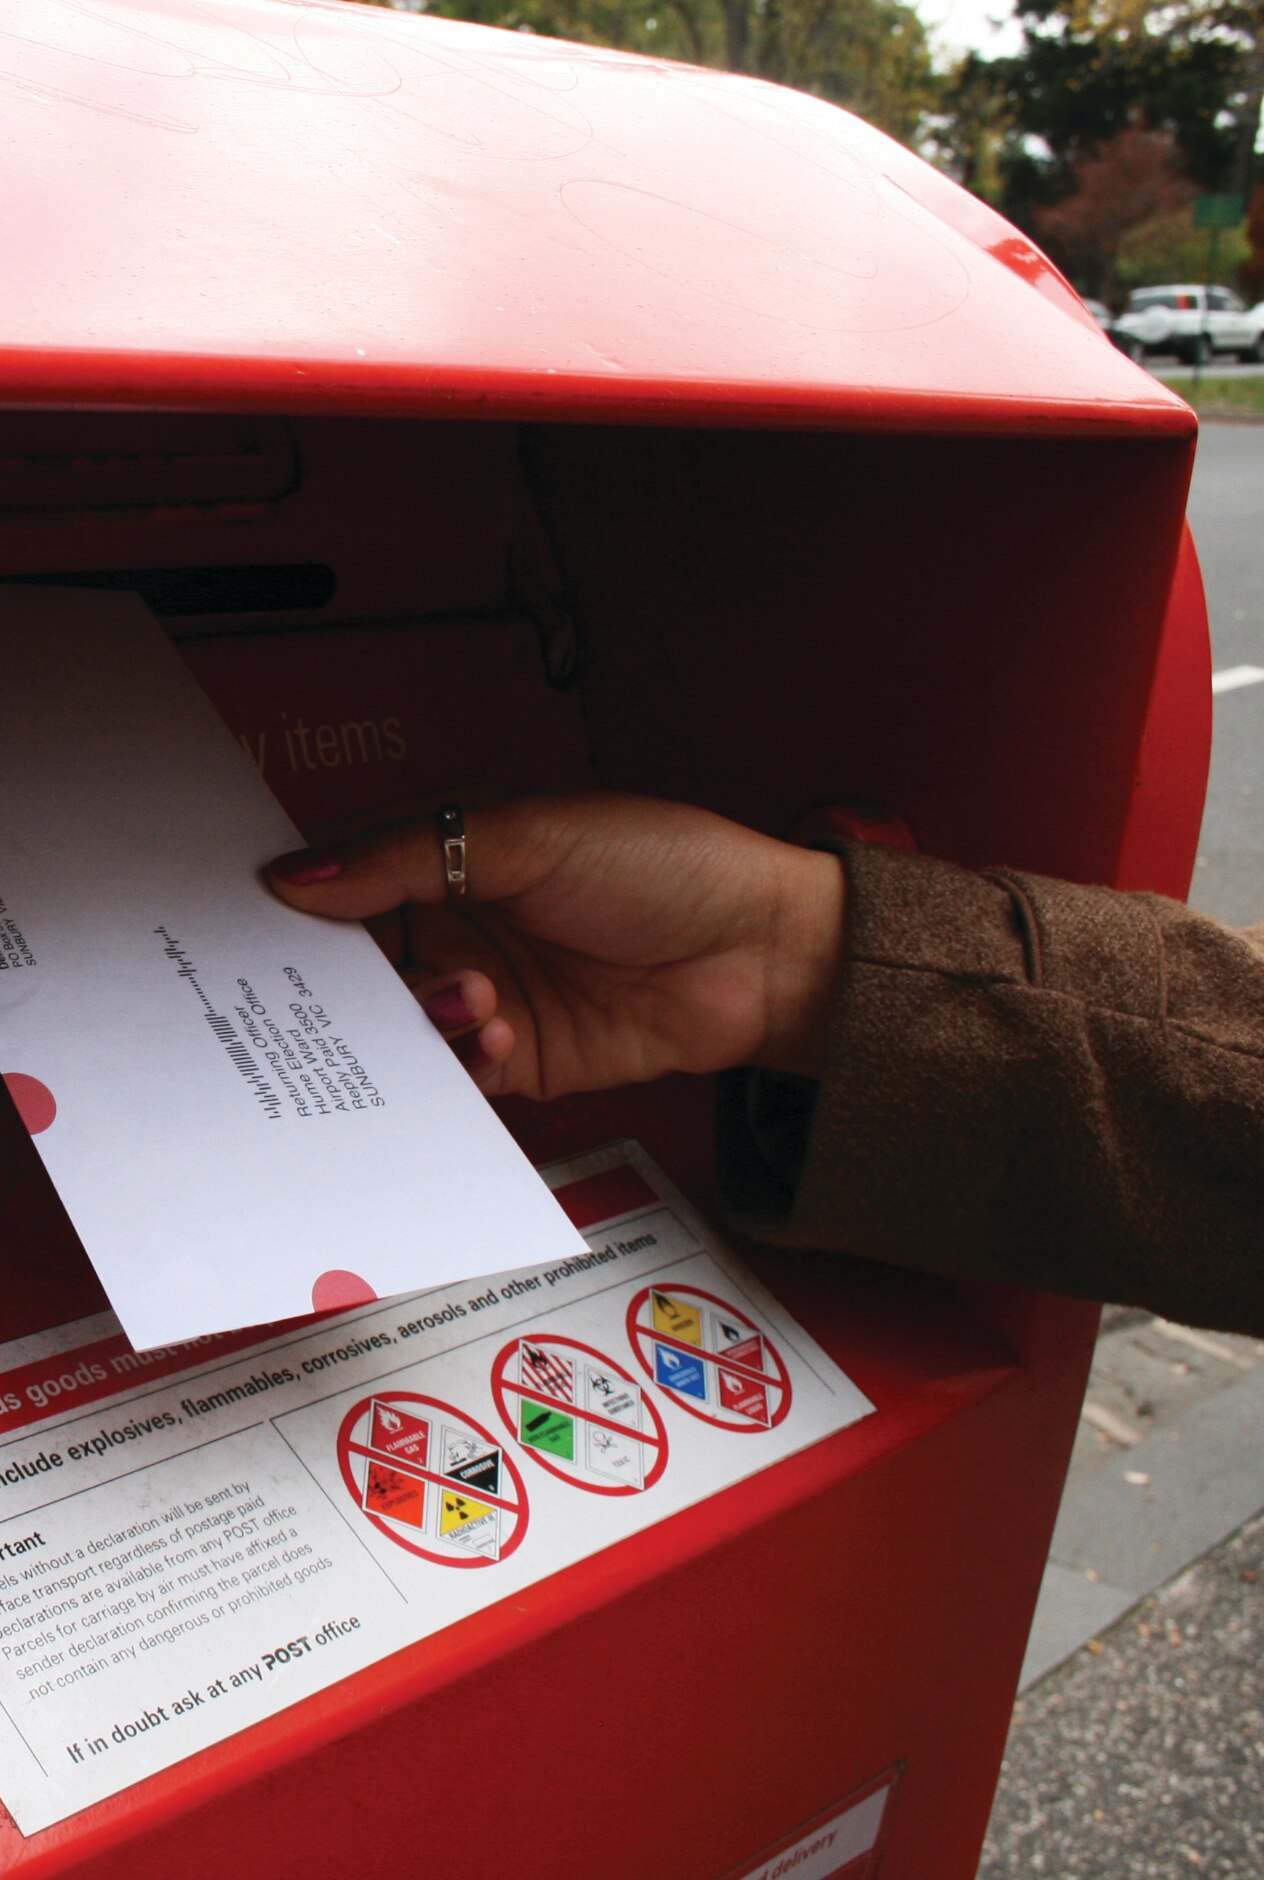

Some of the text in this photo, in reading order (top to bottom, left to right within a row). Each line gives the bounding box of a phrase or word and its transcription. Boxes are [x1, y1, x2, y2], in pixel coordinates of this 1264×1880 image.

[279, 712, 407, 773] items
[0, 933, 15, 951] Box
[2, 918, 37, 966] SUNBURY
[7, 952, 24, 968] PO
[233, 1006, 313, 1117] Returning Officer
[236, 978, 332, 1115] Hume Election Office
[282, 966, 386, 1107] SUNBURY VIC 3429
[285, 1029, 350, 1112] Airport Ward
[288, 1003, 368, 1110] Reply Paid 3500
[25, 1363, 108, 1408] goods
[111, 1344, 180, 1376] must
[67, 1412, 183, 1461] explosives,
[180, 1368, 301, 1418] flammables,
[301, 1332, 398, 1374] corrosives,
[396, 1303, 467, 1339] aerosols
[467, 1288, 500, 1312] and
[500, 1276, 542, 1300] other
[541, 1244, 619, 1287] prohibited
[614, 1230, 658, 1257] items
[384, 1430, 427, 1452] FLAMMABLE
[402, 1442, 421, 1455] GAS
[457, 1457, 496, 1479] CORROSIVE
[19, 1551, 75, 1581] without
[75, 1548, 86, 1560] a
[86, 1518, 161, 1555] declaration
[160, 1505, 185, 1524] will
[183, 1500, 204, 1515] be
[203, 1487, 234, 1507] sent
[231, 1481, 251, 1495] by
[31, 1565, 98, 1600] transport
[97, 1537, 168, 1573] regardless
[168, 1527, 184, 1544] of
[184, 1509, 236, 1540] postage
[236, 1494, 266, 1518] paid
[80, 1587, 104, 1604] are
[105, 1562, 165, 1594] available
[163, 1548, 199, 1568] from
[199, 1537, 224, 1554] any
[222, 1517, 260, 1543] POST
[262, 1506, 297, 1527] office
[448, 1518, 489, 1540] RADIOACTIVE
[0, 1528, 299, 1661] Parcels for carriage by air must have affixed a
[15, 1543, 313, 1680] sender declaration confirming the parcel does
[28, 1557, 333, 1700] not contain any dangerous or prohibited goods
[66, 1616, 361, 1764] If in doubt ask at any POST office
[772, 1829, 838, 1880] delivery
